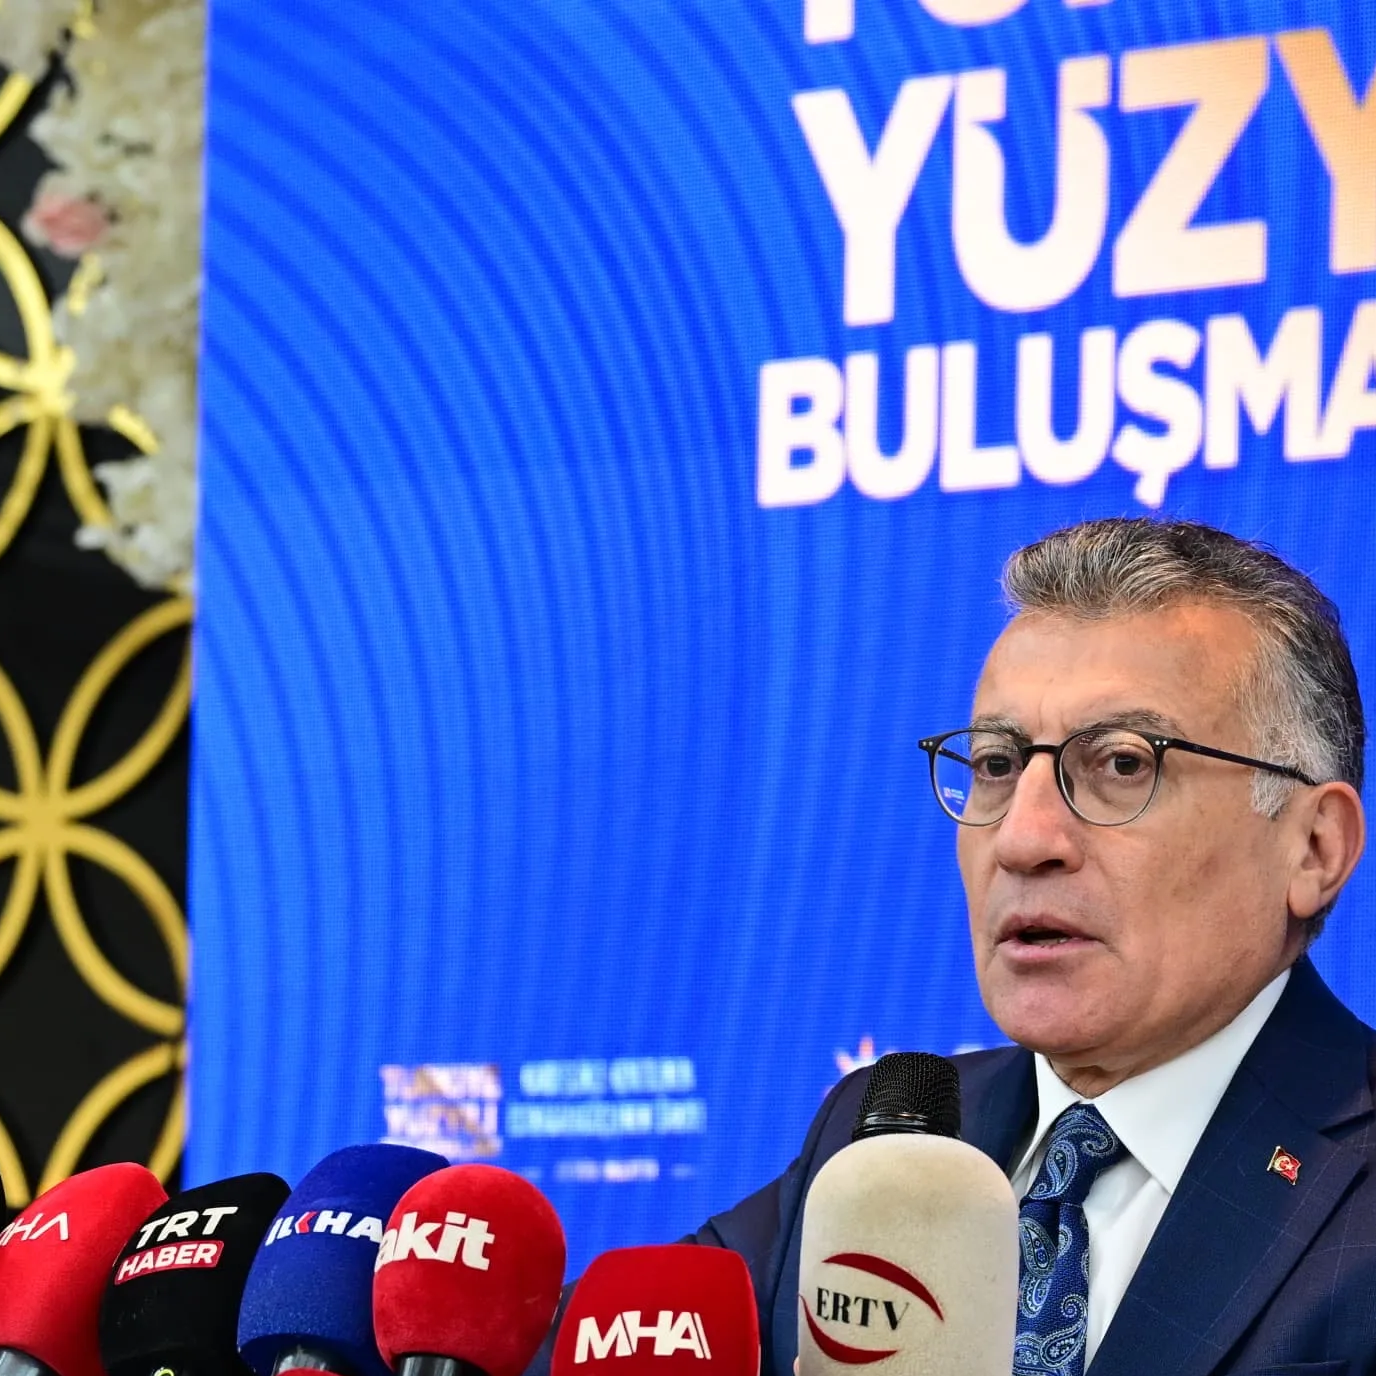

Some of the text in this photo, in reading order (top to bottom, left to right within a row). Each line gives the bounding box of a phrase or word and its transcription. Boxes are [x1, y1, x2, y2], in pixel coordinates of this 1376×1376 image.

[136, 1206, 238, 1249] TRT
[375, 1211, 495, 1272] akit
[117, 1242, 218, 1282] HABER
[816, 1286, 910, 1331] ERTV
[574, 1309, 712, 1364] MHA
